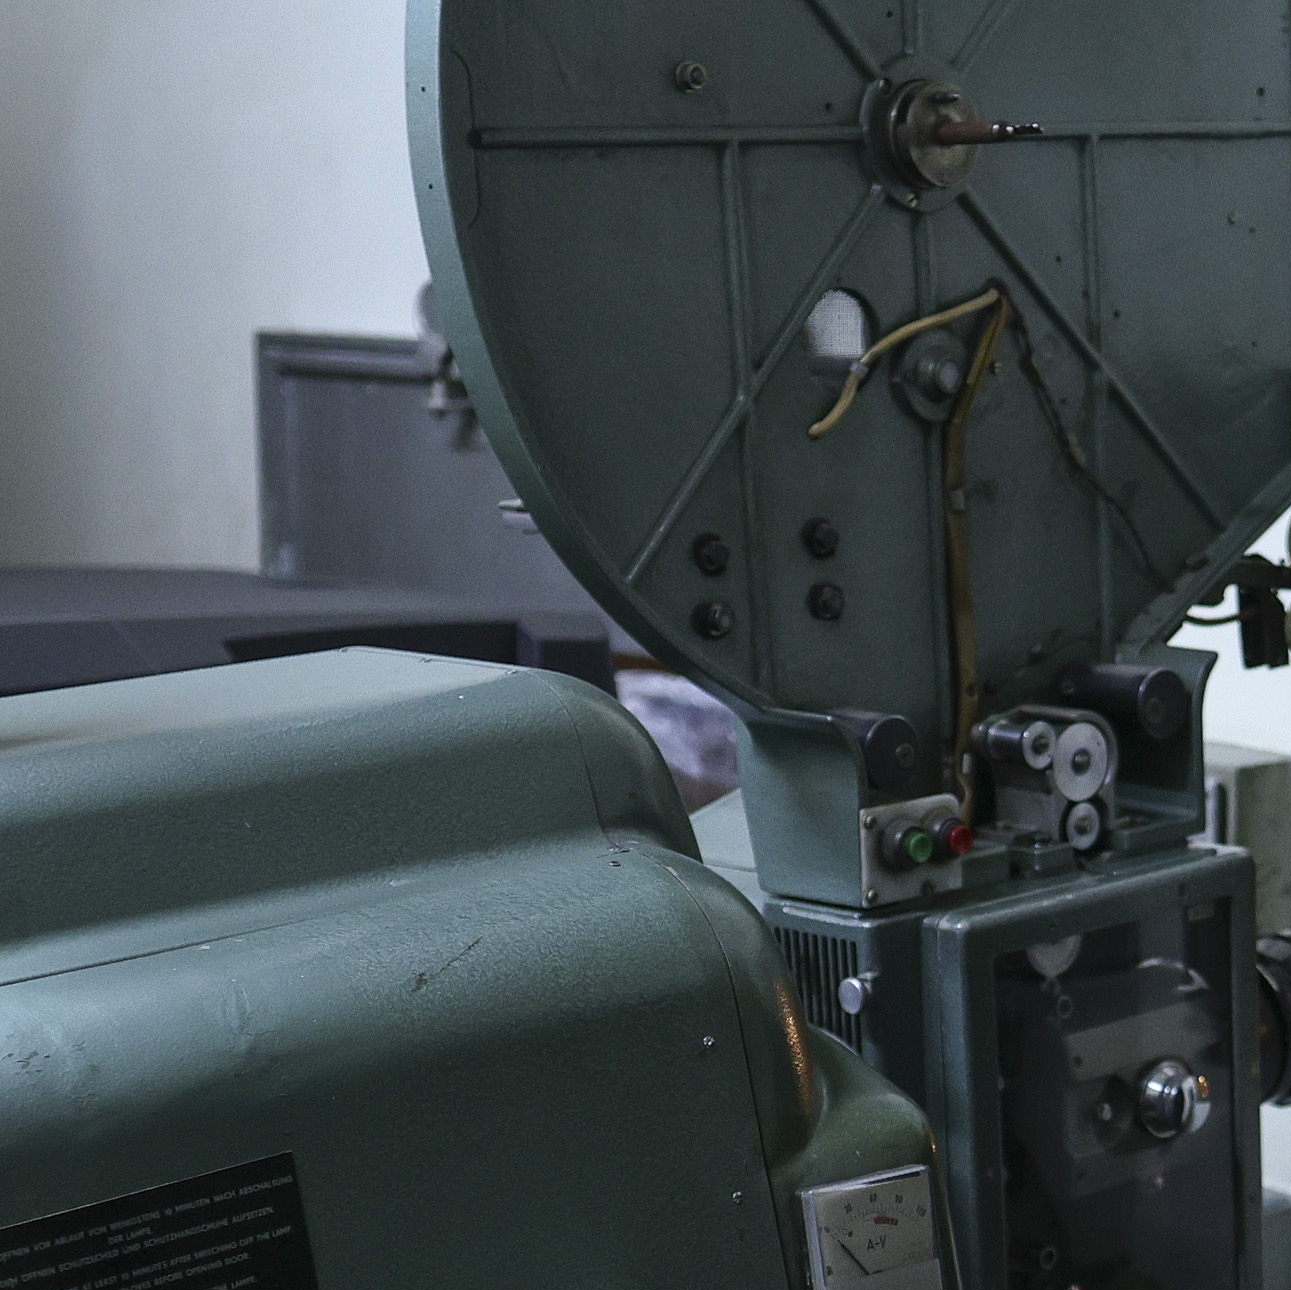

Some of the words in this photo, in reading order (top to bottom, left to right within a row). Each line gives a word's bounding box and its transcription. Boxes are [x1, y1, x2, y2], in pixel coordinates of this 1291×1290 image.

[213, 1190, 236, 1203] NACH
[107, 1234, 125, 1245] DER
[94, 1275, 118, 1288] LEAST
[132, 1261, 168, 1277] MINUTES
[168, 1254, 192, 1267] AFTER
[238, 1236, 255, 1247] OFF
[255, 1232, 271, 1242] THE
[185, 1260, 223, 1277] OPENING
